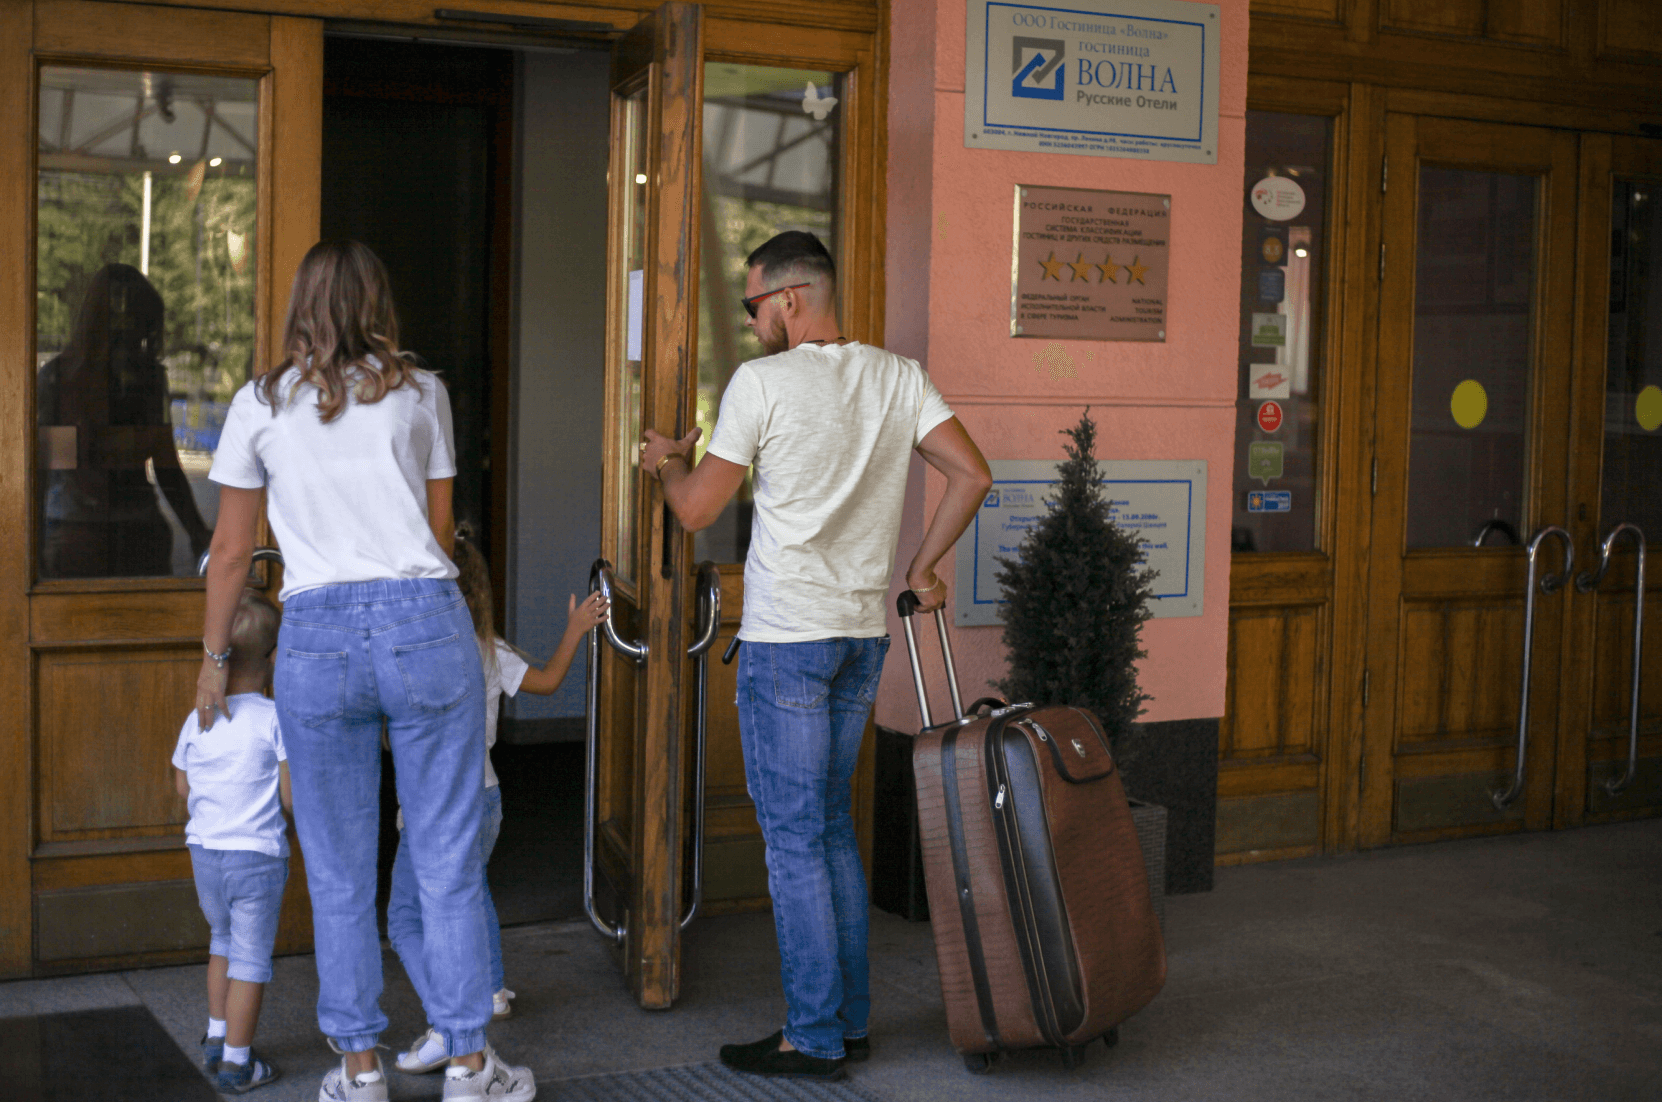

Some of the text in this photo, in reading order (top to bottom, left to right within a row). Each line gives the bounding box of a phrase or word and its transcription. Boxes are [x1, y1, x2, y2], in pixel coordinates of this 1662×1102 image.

[1013, 12, 1169, 40] ООО Гостиница «Волна»
[1079, 41, 1150, 58] гостиница
[1077, 58, 1178, 94] ВОЛНА
[1076, 90, 1178, 111] Русские Отели
[1023, 201, 1168, 218] РОССИЙСКАЯ ФЕДЕРАЦИЯ
[1061, 215, 1130, 227] ГОСУДАРСТВЕННАЯ
[1045, 224, 1143, 237] СИСТЕМА КЛАССИФИКАЦИИ
[1022, 231, 1059, 242] ГОСТИНИЦ
[1066, 234, 1092, 243] ДРУГИХ
[1093, 236, 1121, 245] СРЕДСТВ
[1021, 293, 1068, 301] ФЕДЕРАЛЬНЫЙ
[1021, 303, 1080, 311] ИСПОЛНИТЕЛЬНОЙ
[1110, 315, 1163, 324] ADMINISTRATION
